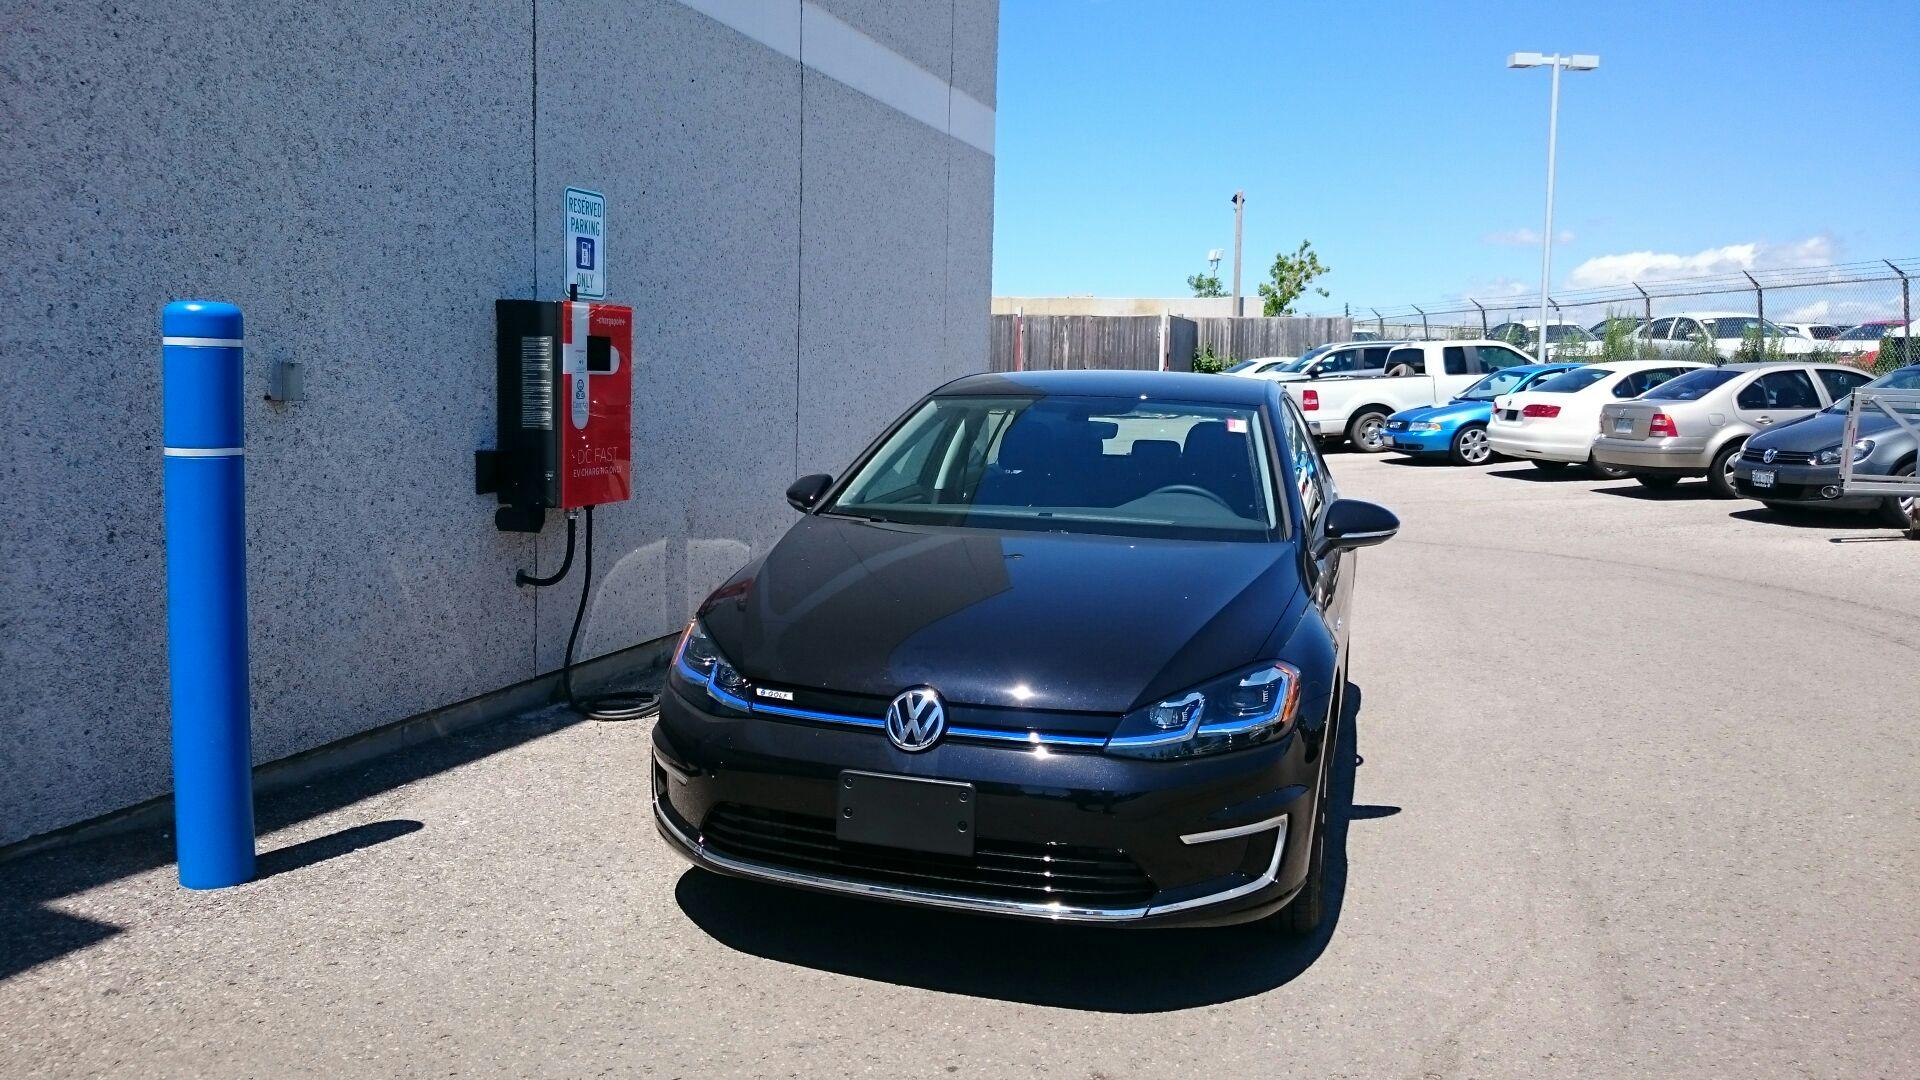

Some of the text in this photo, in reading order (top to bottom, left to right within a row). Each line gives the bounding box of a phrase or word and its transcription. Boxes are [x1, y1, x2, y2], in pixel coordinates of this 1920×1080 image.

[568, 197, 602, 218] RESERVED
[570, 216, 600, 237] PARKING
[576, 272, 595, 289] ONLY
[577, 446, 619, 464] DC FAST
[573, 465, 622, 478] EV CHARGING ONLY
